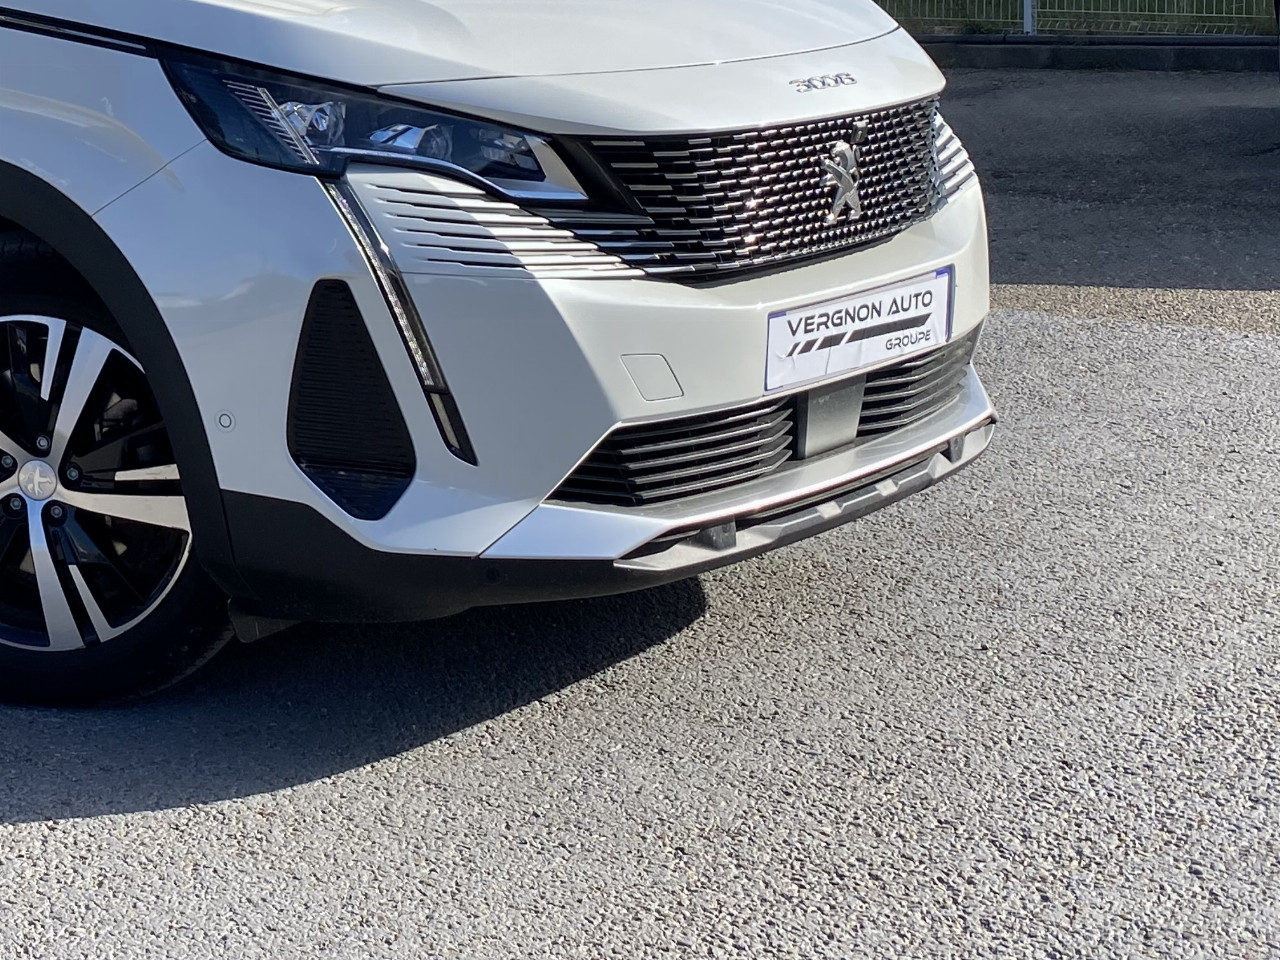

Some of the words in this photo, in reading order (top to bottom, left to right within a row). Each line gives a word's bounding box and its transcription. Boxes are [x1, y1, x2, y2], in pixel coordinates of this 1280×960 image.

[788, 72, 858, 93] 3008
[787, 300, 882, 337] VERGNON
[887, 289, 933, 316] AUTO
[885, 329, 931, 351] GROUPE
